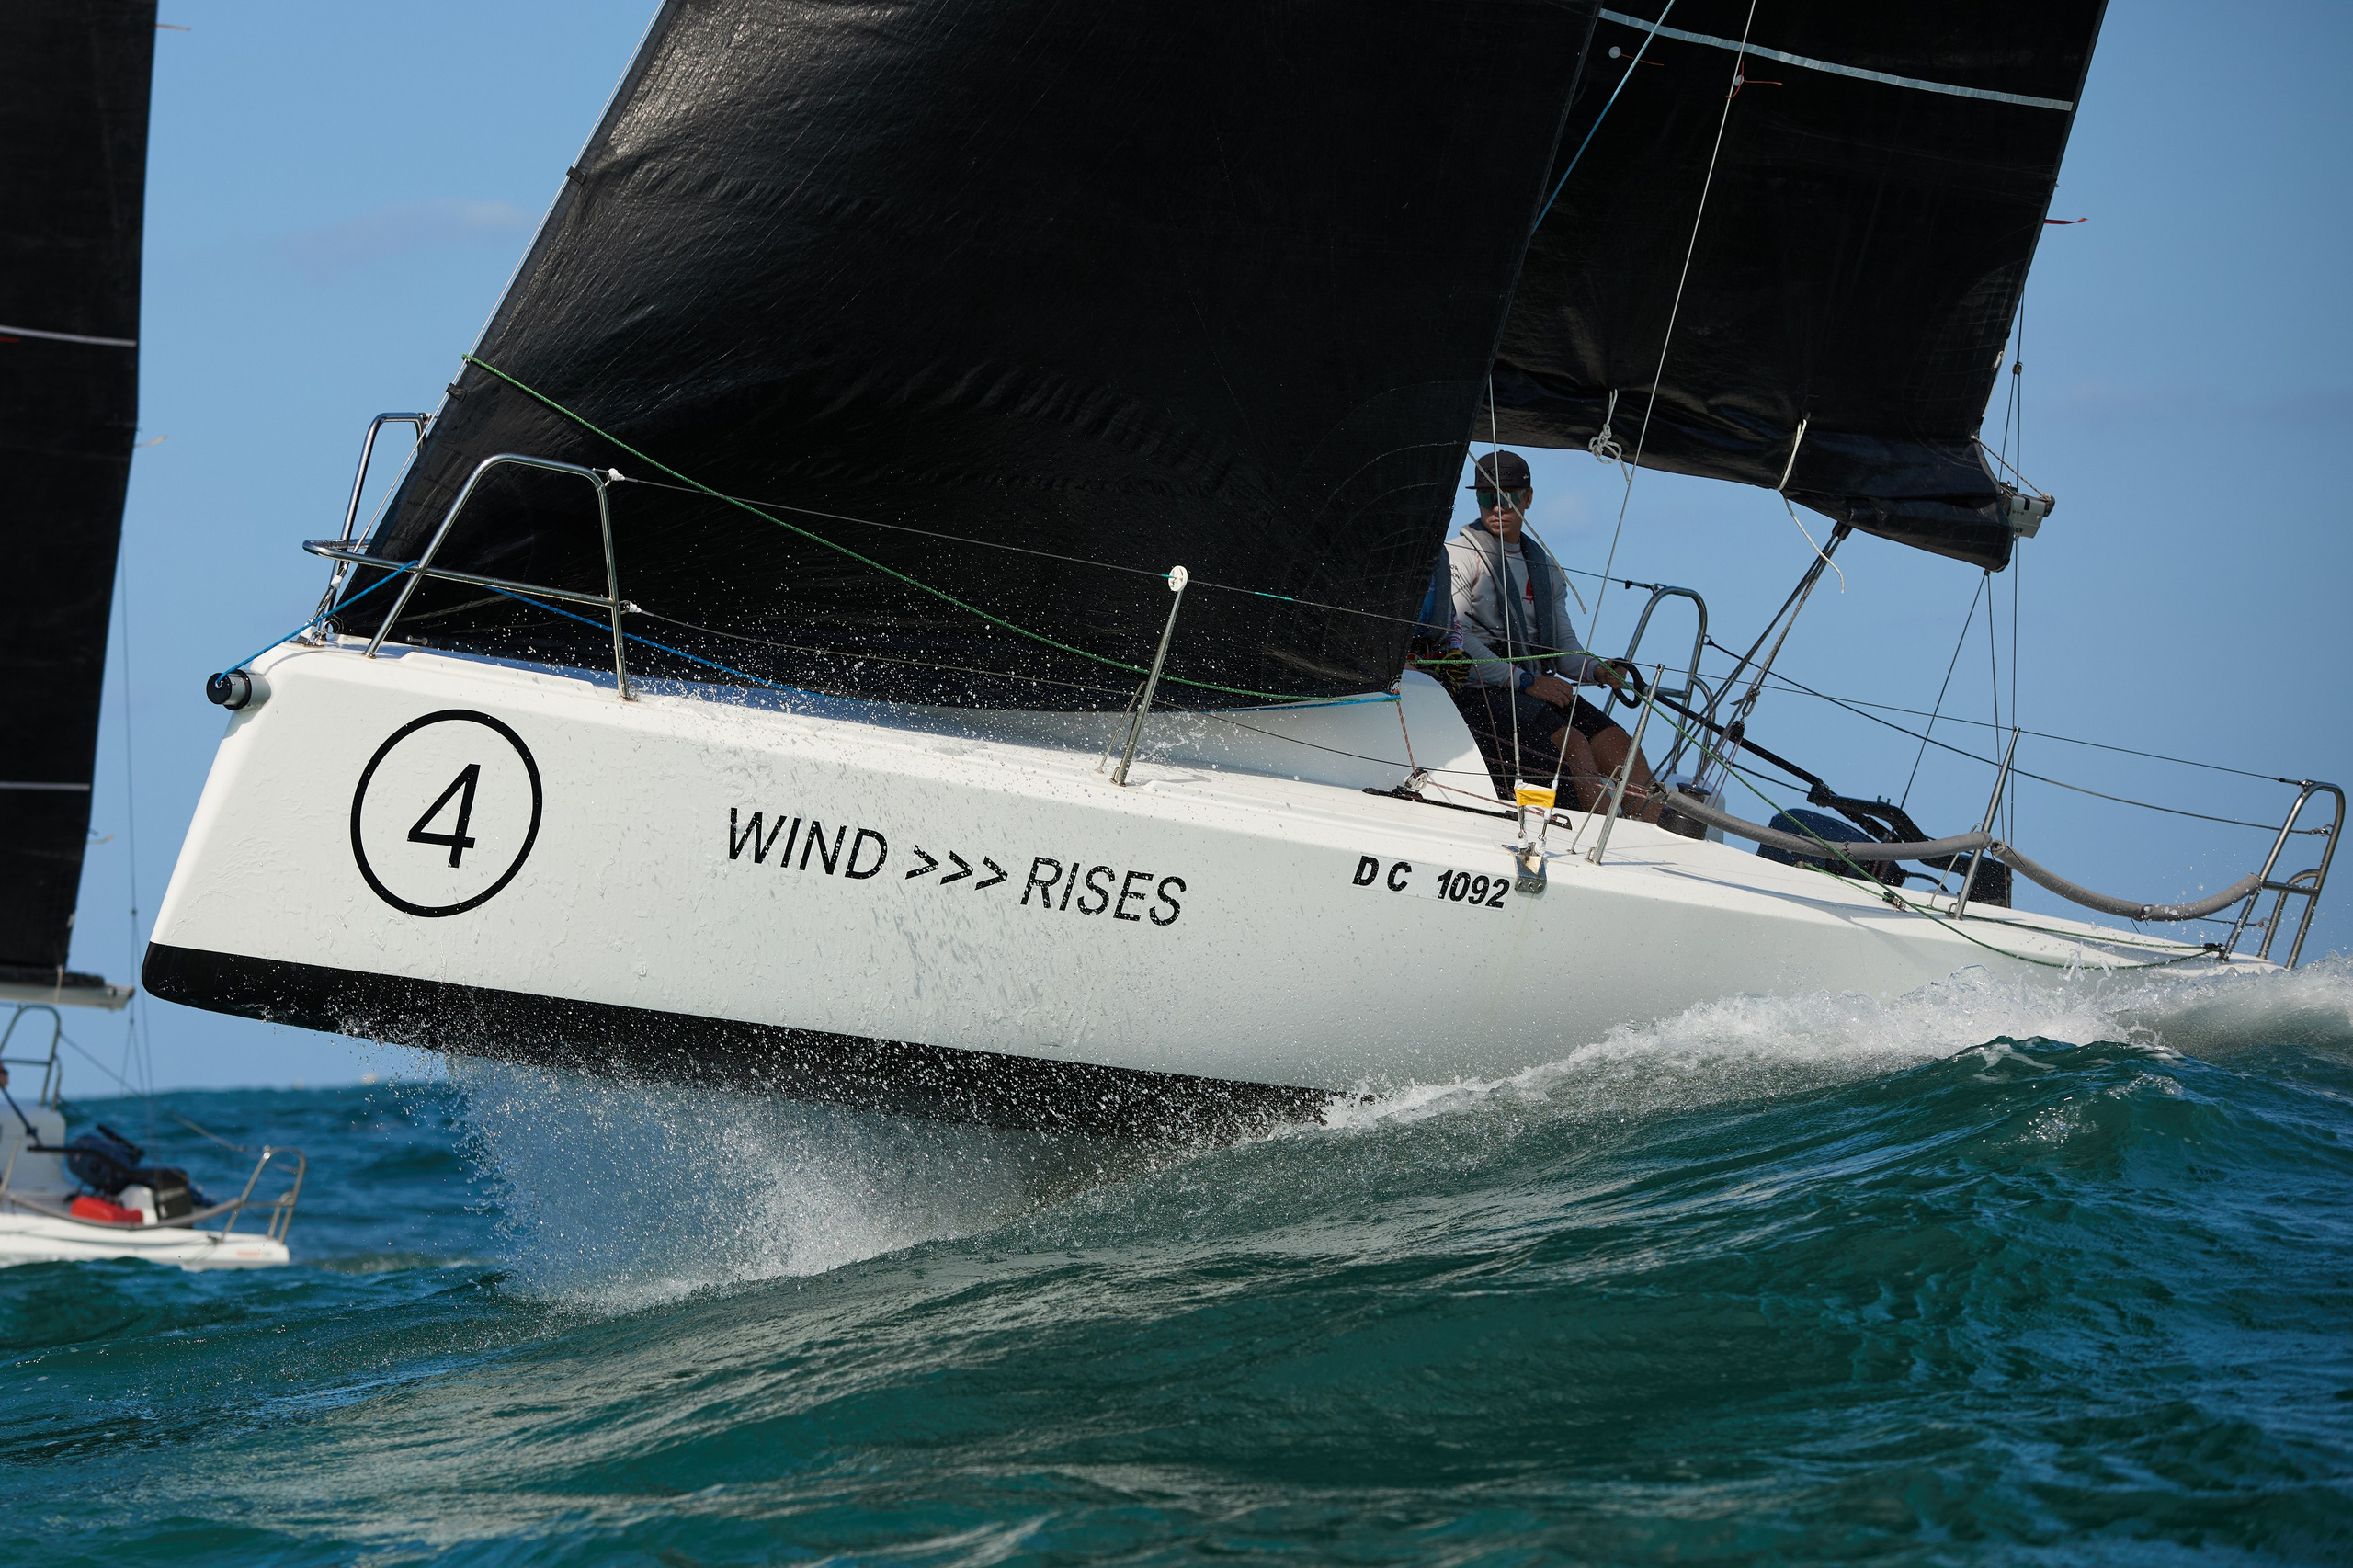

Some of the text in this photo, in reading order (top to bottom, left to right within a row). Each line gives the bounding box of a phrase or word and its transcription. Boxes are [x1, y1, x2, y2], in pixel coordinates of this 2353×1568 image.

[406, 763, 481, 869] 4
[727, 806, 888, 881] WIND
[1019, 855, 1188, 927] RISES
[1436, 868, 1510, 909] 1092
